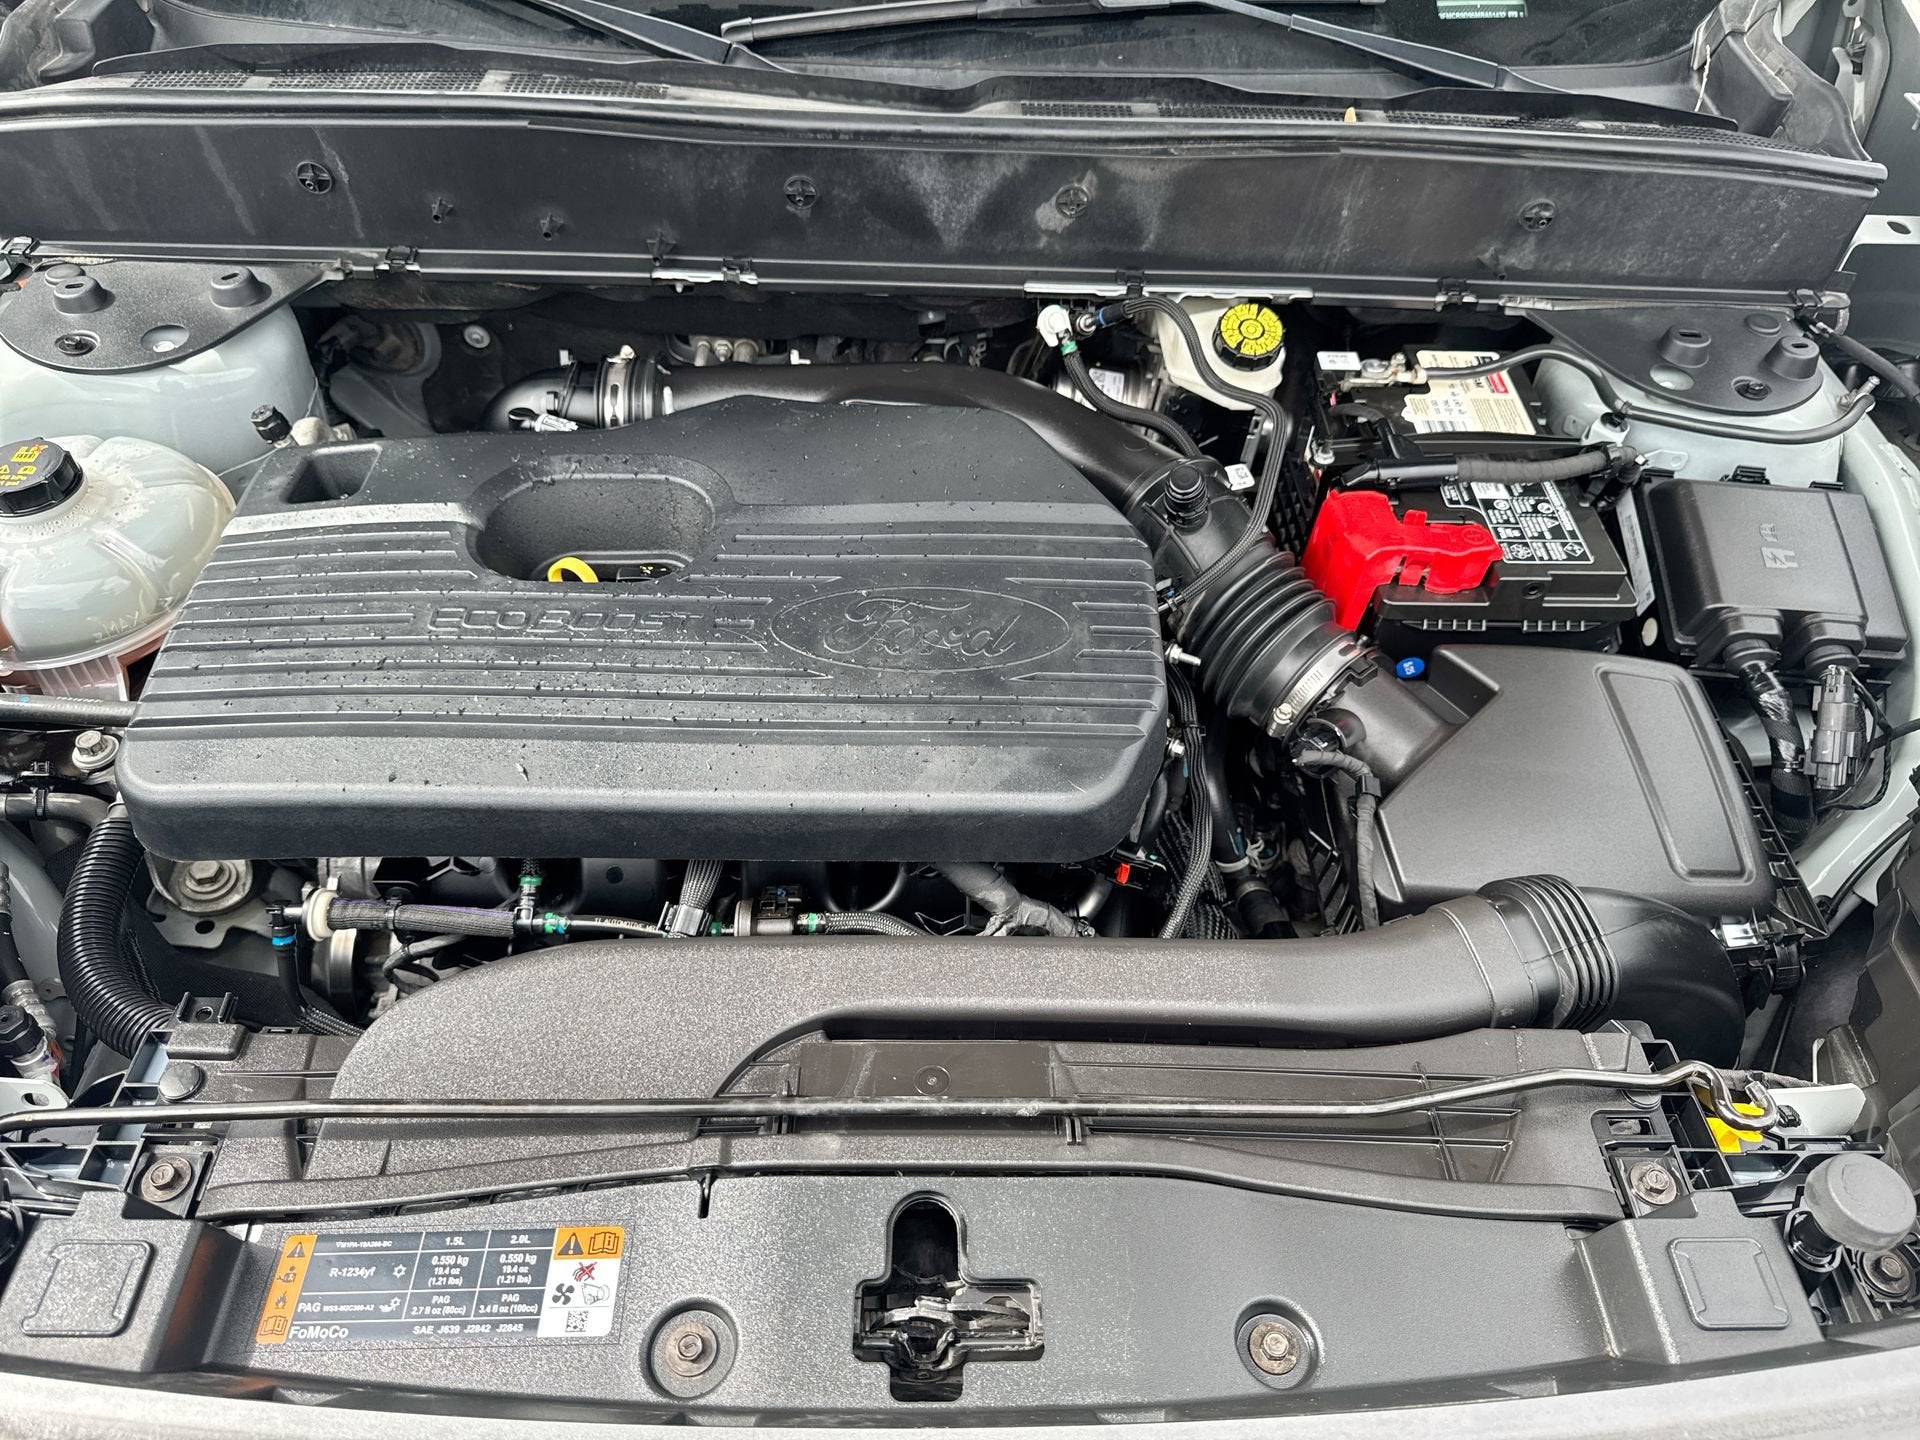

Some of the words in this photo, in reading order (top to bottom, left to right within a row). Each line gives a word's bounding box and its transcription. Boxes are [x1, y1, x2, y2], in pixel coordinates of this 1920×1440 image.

[823, 598, 1021, 656] Ford
[445, 1236, 465, 1246] 1.5L
[510, 1234, 531, 1244] 2.0L
[431, 1255, 456, 1266] 0.550
[457, 1255, 469, 1267] kg
[499, 1253, 524, 1264] 0.550
[525, 1253, 537, 1265] kg
[329, 1266, 377, 1279] R-1234yf
[434, 1267, 449, 1275] 19.4
[450, 1267, 461, 1275] oz
[502, 1265, 518, 1274] 19.4
[431, 1295, 451, 1304] PAG
[501, 1293, 520, 1302] PAG
[297, 1302, 322, 1313] PAG
[411, 1306, 424, 1316] 2.7
[431, 1307, 441, 1315] oz
[478, 1305, 491, 1314] 3.4
[499, 1305, 509, 1313] oz
[288, 1325, 349, 1340] FoMoCo
[412, 1326, 434, 1335] SAE
[437, 1325, 460, 1334] J639
[463, 1324, 492, 1334] J2842
[495, 1323, 524, 1333] J2845
